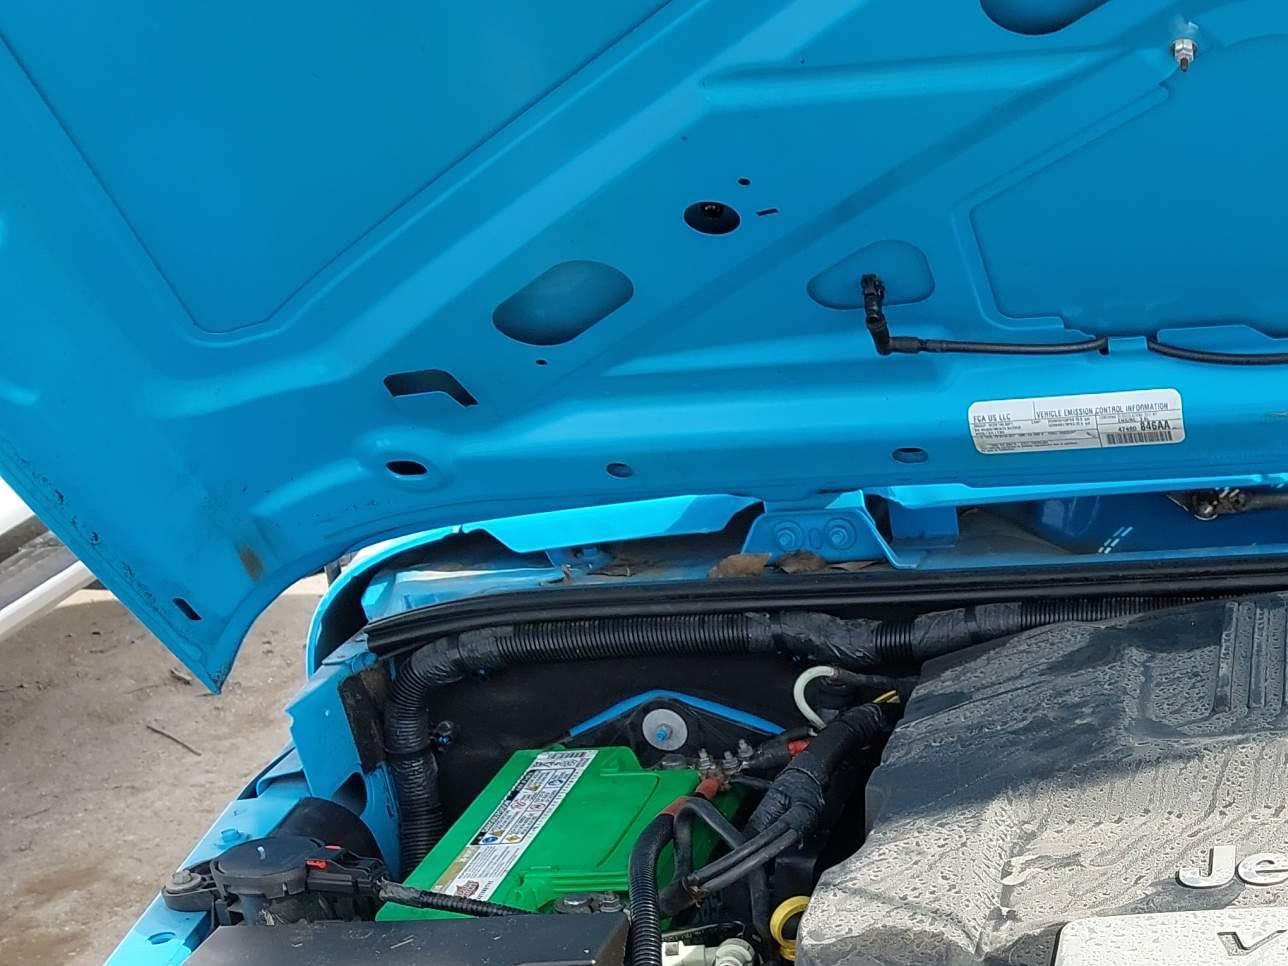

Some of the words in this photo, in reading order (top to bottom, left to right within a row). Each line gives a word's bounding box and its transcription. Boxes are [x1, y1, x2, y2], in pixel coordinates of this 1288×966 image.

[1036, 410, 1061, 418] VEHICLE
[1063, 408, 1093, 417] EMISSION
[1095, 405, 1123, 415] CONTROL
[1125, 403, 1169, 412] INFORMATION
